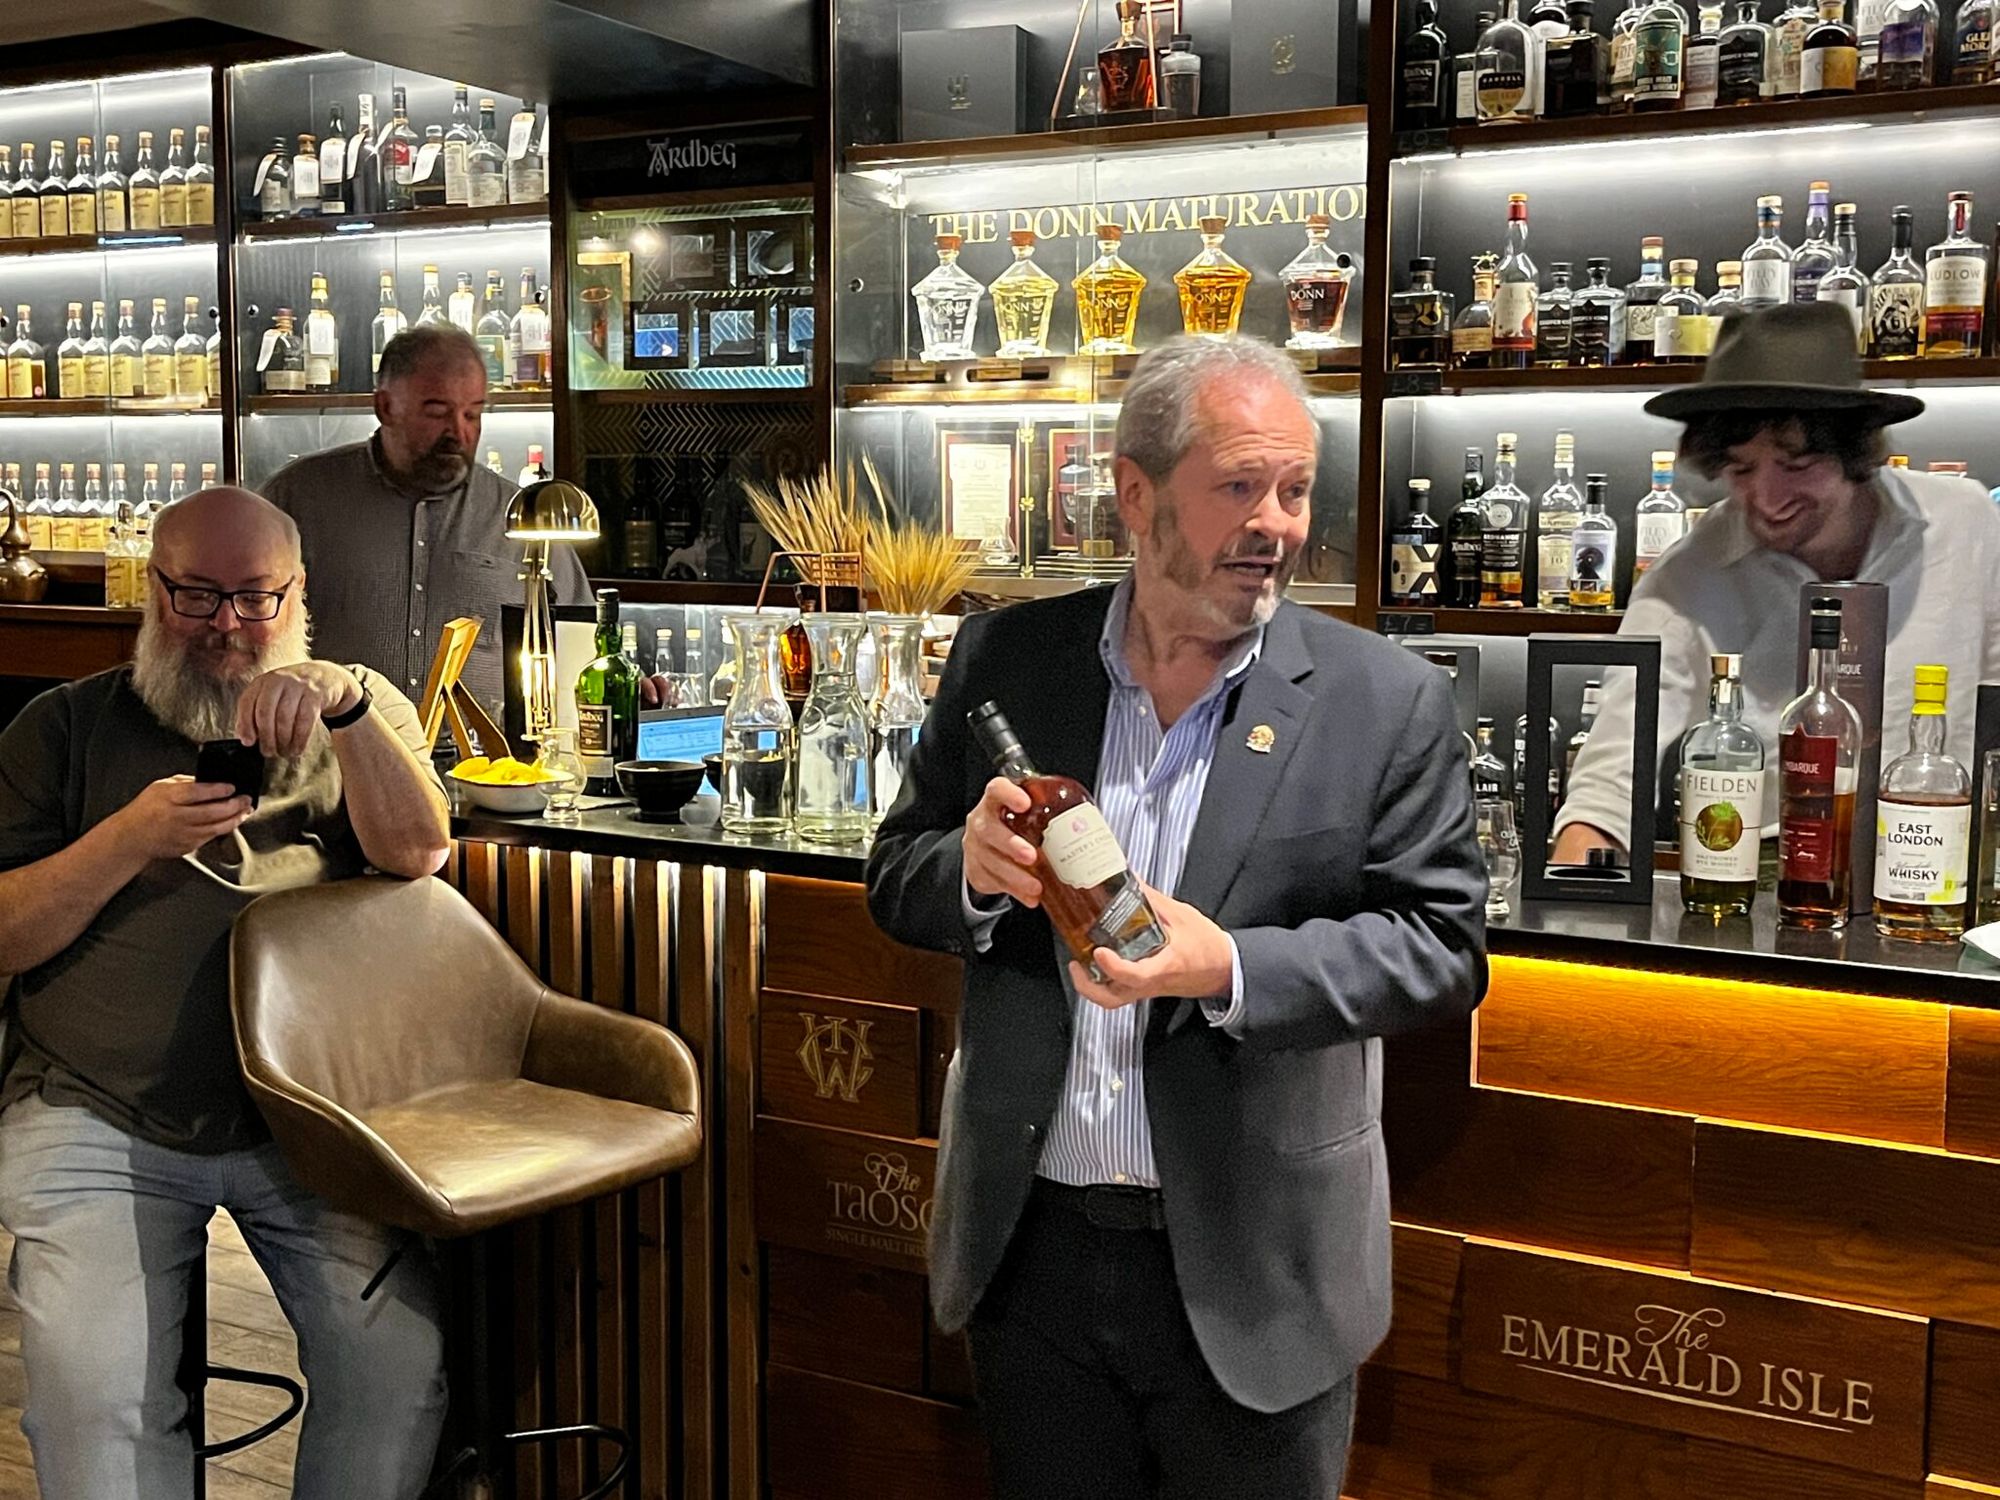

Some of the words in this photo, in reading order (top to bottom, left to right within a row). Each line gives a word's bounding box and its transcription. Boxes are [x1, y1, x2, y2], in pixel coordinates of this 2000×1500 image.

[646, 138, 737, 177] Ardbeg
[929, 213, 998, 245] THE
[1929, 269, 1981, 280] LUDLOW
[1290, 288, 1324, 301] DONN
[1475, 783, 1499, 792] LAIR
[1686, 774, 1758, 793] FIELDEN
[1898, 823, 1932, 835] EAST
[1888, 833, 1943, 846] LONDON
[1888, 867, 1940, 881] WHISKY
[1634, 1304, 1726, 1351] The
[1501, 1314, 1743, 1397] EMERALD
[1758, 1362, 1875, 1426] ISLE
